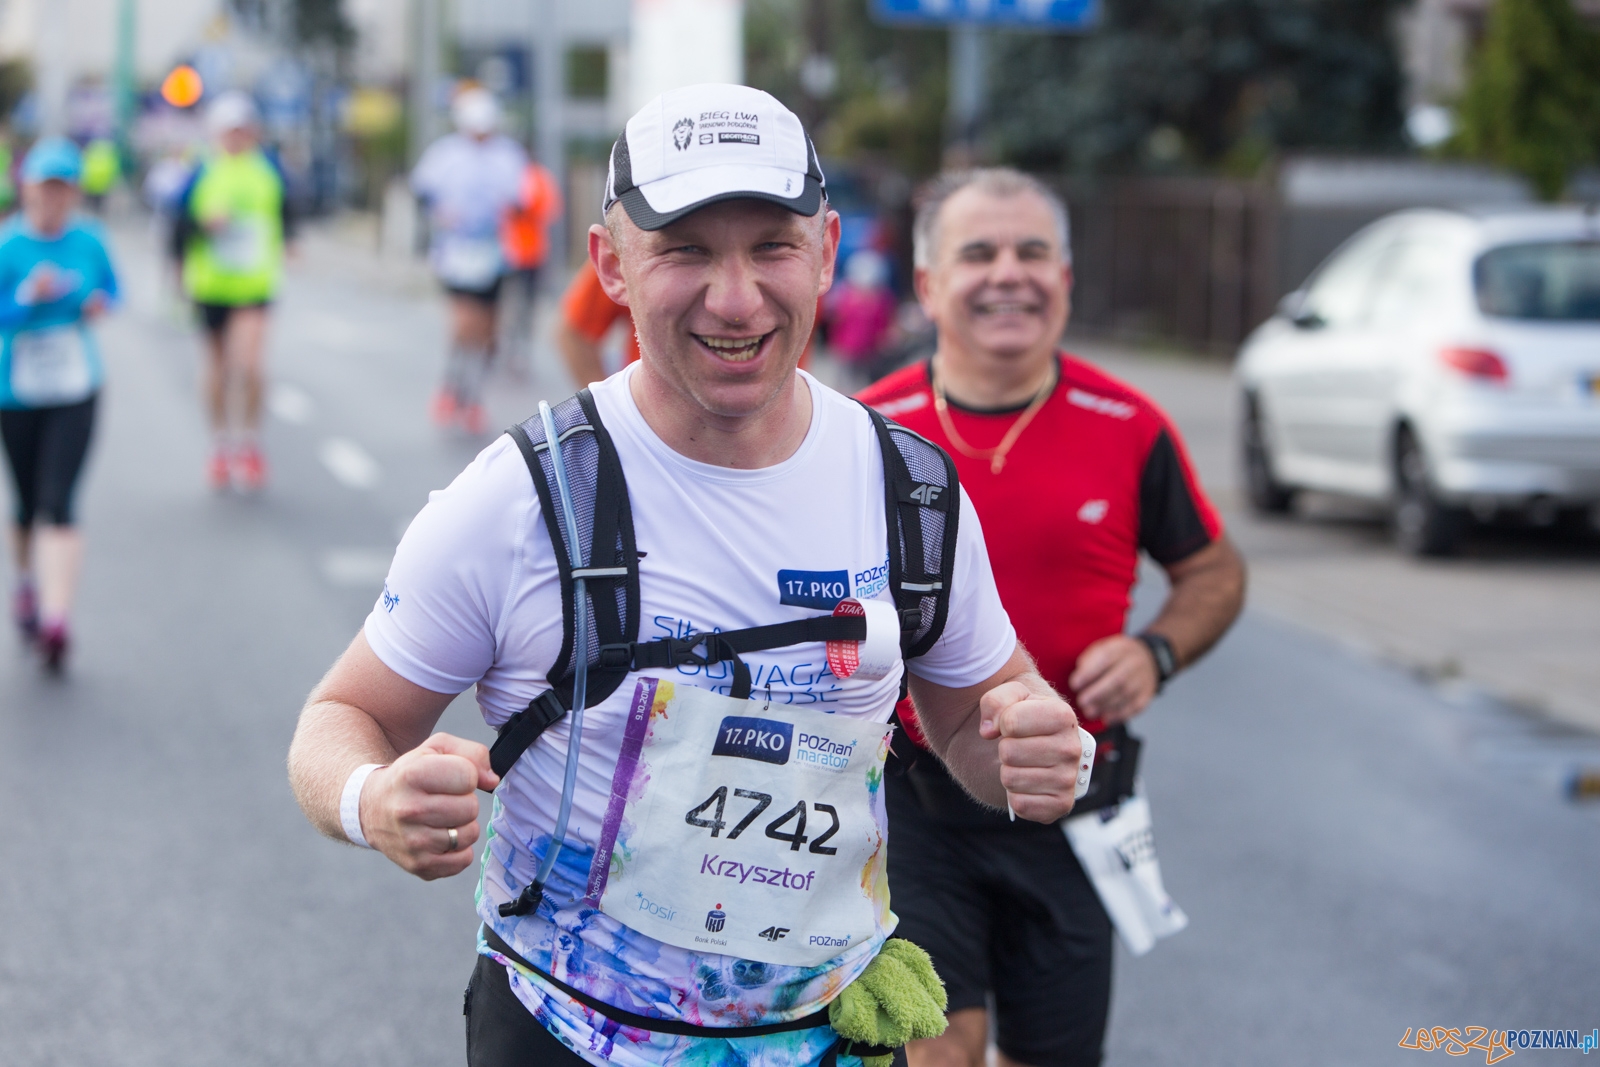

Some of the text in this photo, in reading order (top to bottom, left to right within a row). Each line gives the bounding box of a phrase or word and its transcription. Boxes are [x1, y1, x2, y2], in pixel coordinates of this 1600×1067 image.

[700, 111, 759, 123] BIEG LWA
[910, 483, 943, 506] 4F
[797, 749, 849, 769] maraton
[684, 785, 840, 856] 4742
[700, 853, 815, 891] Krzysztof
[694, 935, 728, 947] Bank Polski
[758, 926, 791, 942] 4F
